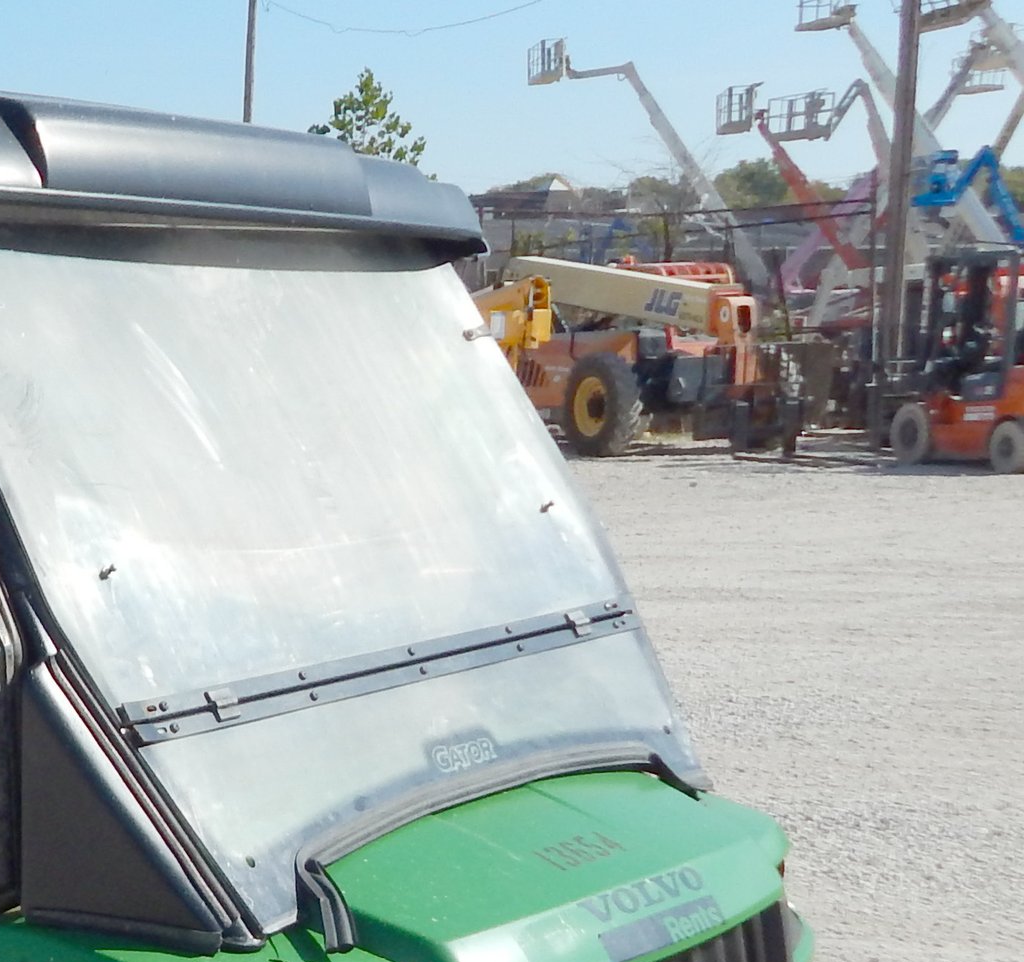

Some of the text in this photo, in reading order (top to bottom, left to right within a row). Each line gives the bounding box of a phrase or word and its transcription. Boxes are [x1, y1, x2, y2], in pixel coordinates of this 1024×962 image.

[644, 288, 683, 317] JLG
[432, 737, 497, 773] GATOR
[534, 831, 626, 871] 13654
[577, 866, 704, 923] VOLVO
[663, 906, 722, 943] Rents
